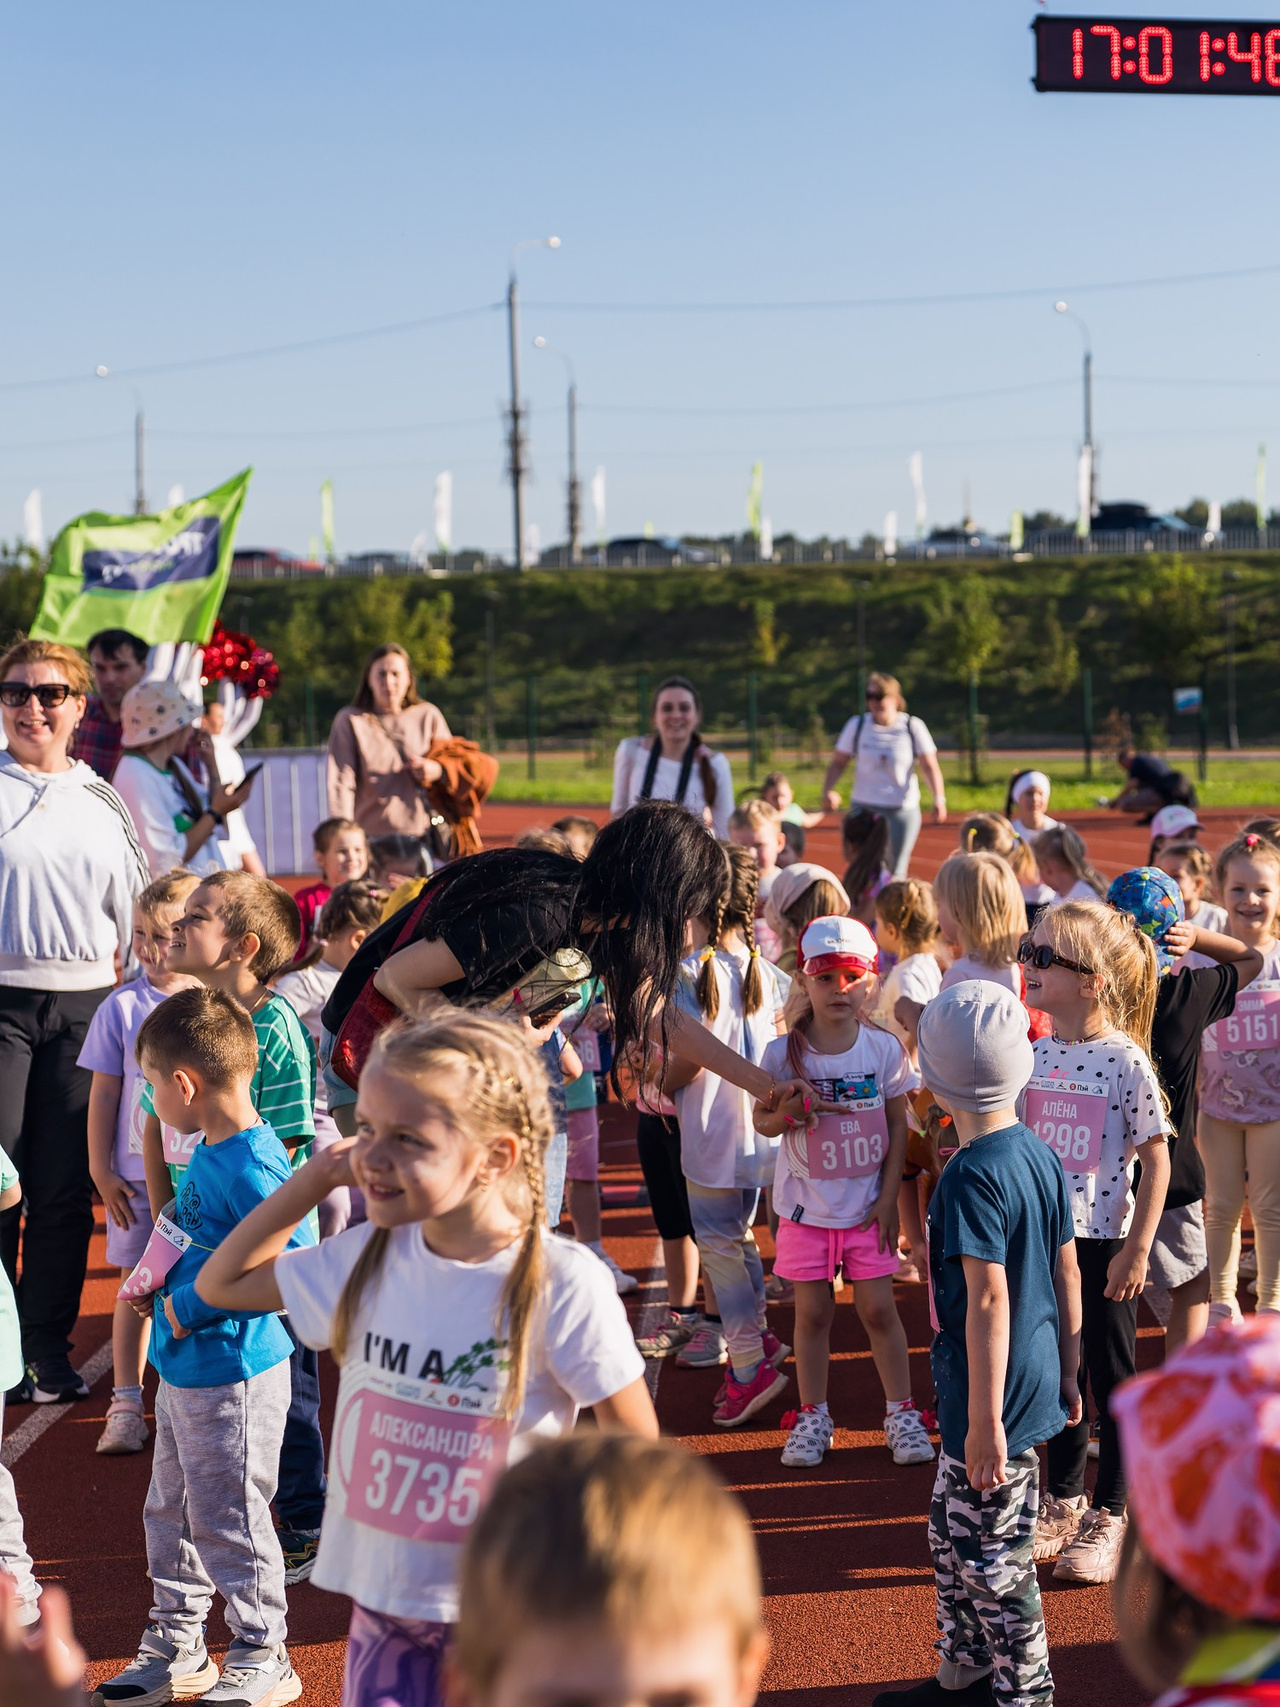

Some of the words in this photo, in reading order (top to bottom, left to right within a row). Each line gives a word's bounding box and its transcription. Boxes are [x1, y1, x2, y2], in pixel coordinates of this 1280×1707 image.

[1227, 1013, 1279, 1043] 5151
[1077, 1084, 1089, 1092] Пэй
[1041, 1100, 1078, 1119] АЛЁНА
[840, 1120, 861, 1135] ЕВА
[1033, 1121, 1091, 1161] 1298
[821, 1133, 883, 1171] 3103
[160, 1223, 173, 1236] Пэй
[364, 1331, 411, 1376] I'M
[417, 1349, 446, 1384] A
[369, 1410, 494, 1462] АЛЕКСАНДРА
[364, 1447, 484, 1527] 3735
